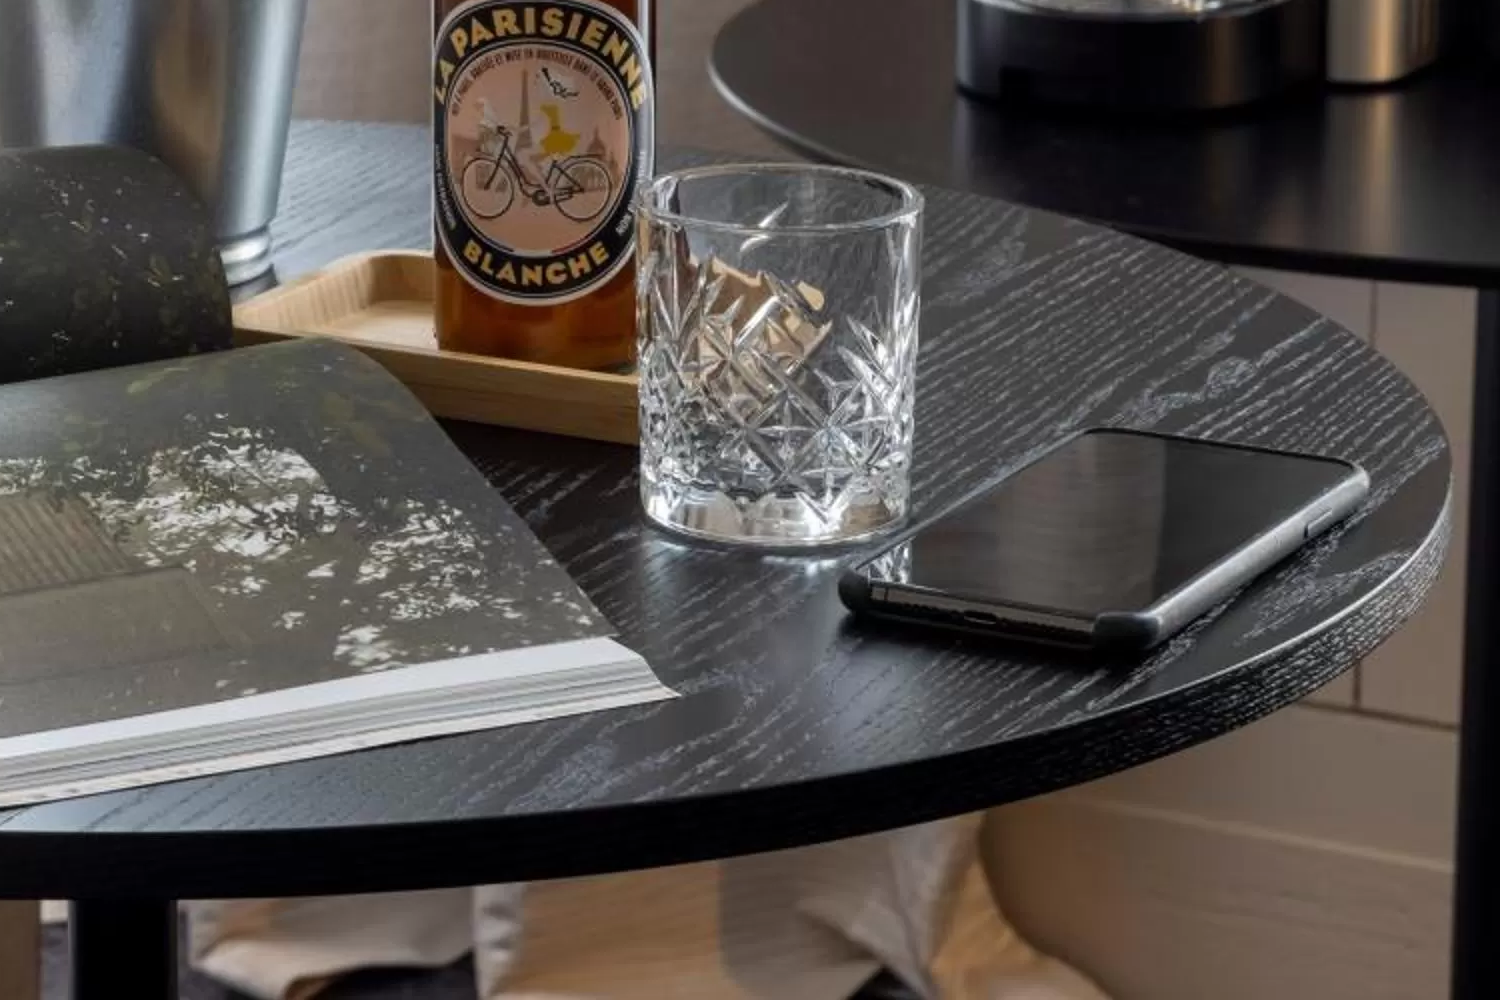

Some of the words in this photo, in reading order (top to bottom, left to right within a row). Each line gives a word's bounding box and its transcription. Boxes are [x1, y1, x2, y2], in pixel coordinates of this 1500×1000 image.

[435, 58, 456, 106] LA
[451, 6, 647, 112] PARISIENNE
[463, 239, 610, 287] BLANCHE
